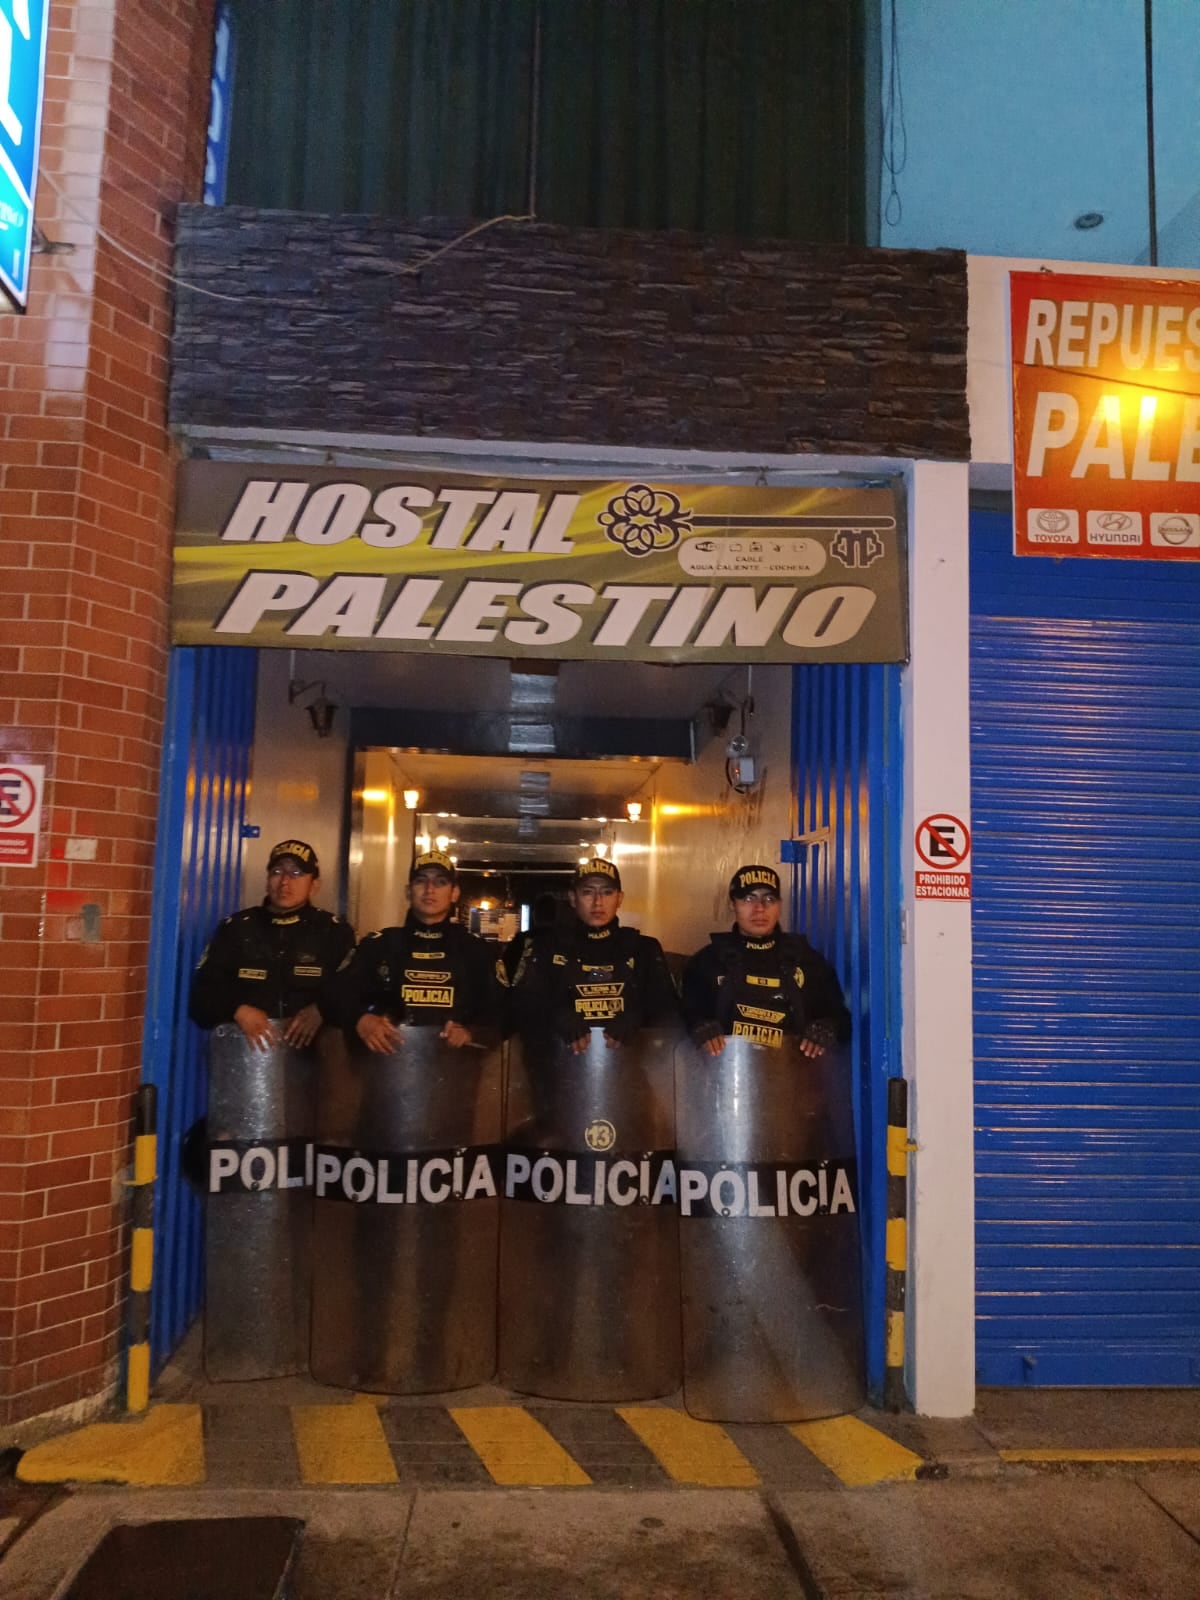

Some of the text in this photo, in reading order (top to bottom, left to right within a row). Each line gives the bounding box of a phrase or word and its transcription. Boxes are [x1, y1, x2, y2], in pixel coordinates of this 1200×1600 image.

[221, 481, 583, 554] HOSTAL
[1034, 534, 1073, 543] TOYOTA
[1090, 533, 1141, 543] HYUNDAI
[215, 572, 877, 648] PALESTINO
[930, 826, 956, 857] E
[740, 871, 776, 888] POLICIA
[919, 874, 966, 885] PROHIBIDO
[916, 886, 970, 897] ESTACIONAR
[405, 989, 450, 1003] POLICIA
[576, 1000, 608, 1013] POLICIA
[735, 1023, 780, 1047] POLICIA
[588, 1125, 611, 1147] 13
